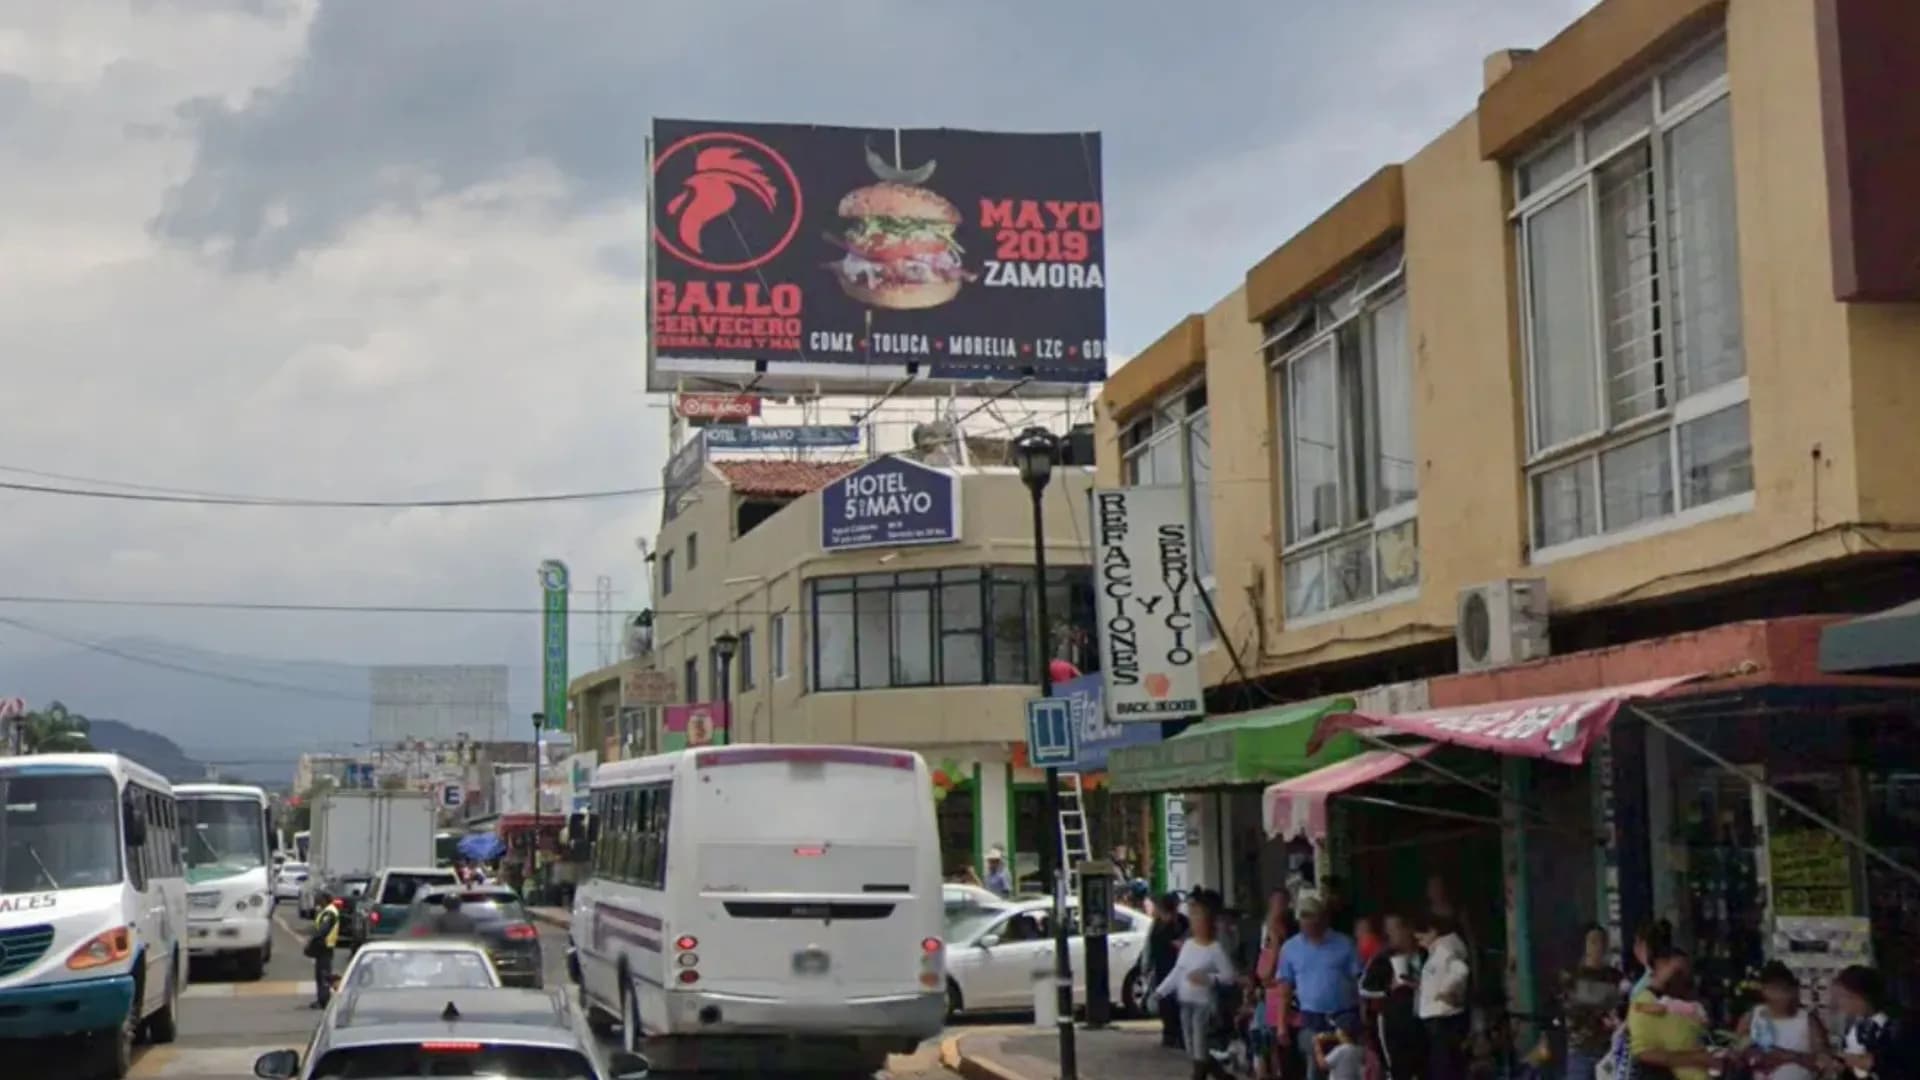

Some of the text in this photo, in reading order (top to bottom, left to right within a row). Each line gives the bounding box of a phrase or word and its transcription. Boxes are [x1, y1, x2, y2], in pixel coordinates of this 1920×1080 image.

[980, 198, 1102, 230] MAYO
[995, 229, 1088, 262] 2019
[983, 260, 1105, 288] ZAMORA
[809, 331, 854, 353] CDMX
[872, 332, 930, 355] TOLUCA
[948, 335, 1018, 358] MORELIA
[1035, 337, 1063, 359] LZC
[844, 471, 907, 498] HOTEL
[844, 498, 857, 520] 5
[866, 491, 932, 518] MAYO
[1099, 492, 1140, 686] REFACCIONES
[1158, 523, 1193, 666] SERVICIO
[1135, 595, 1163, 615] Y
[444, 786, 460, 805] E
